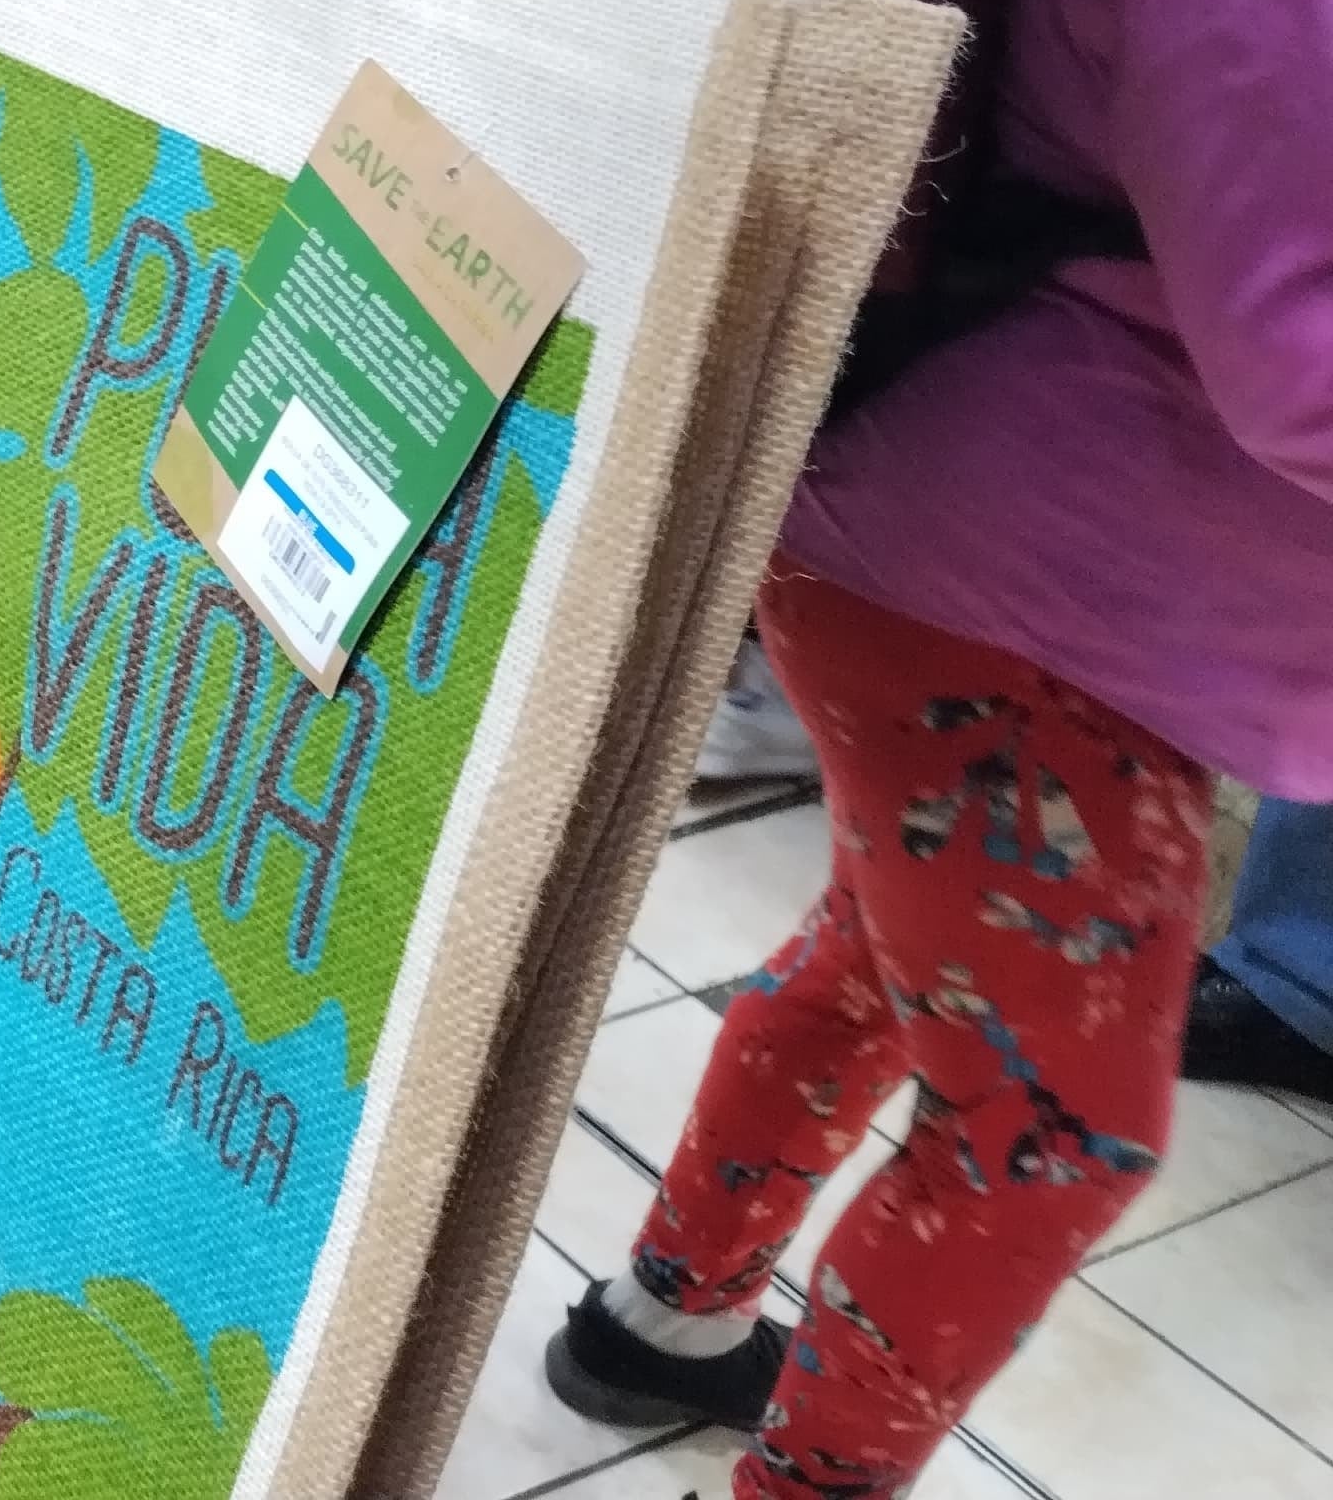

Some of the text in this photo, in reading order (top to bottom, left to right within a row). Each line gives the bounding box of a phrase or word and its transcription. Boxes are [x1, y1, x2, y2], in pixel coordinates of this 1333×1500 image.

[332, 122, 414, 211] SAVE
[425, 214, 536, 332] EARTH
[28, 498, 381, 960] VIDA
[165, 1000, 300, 1206] RICA
